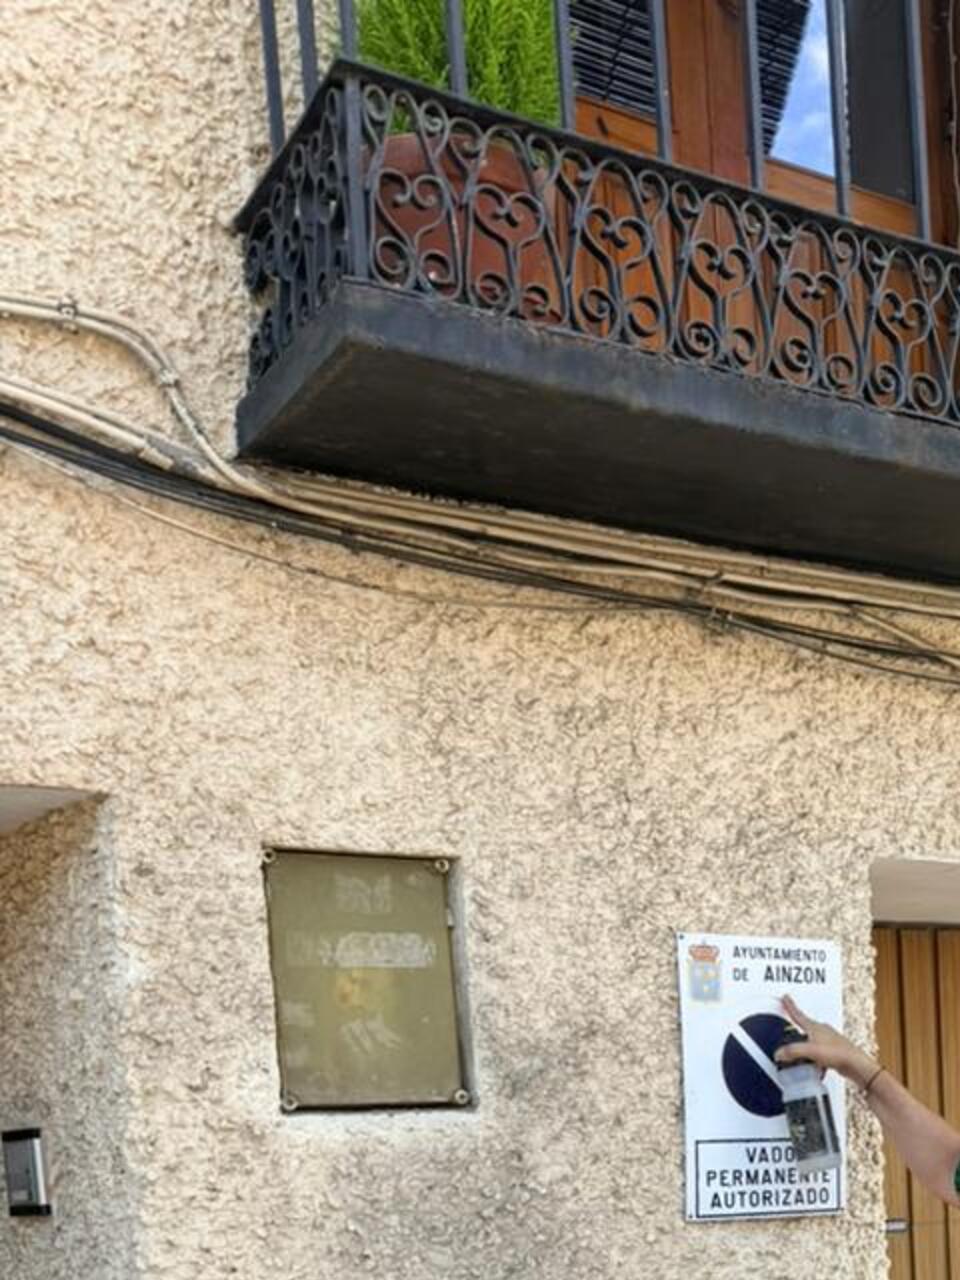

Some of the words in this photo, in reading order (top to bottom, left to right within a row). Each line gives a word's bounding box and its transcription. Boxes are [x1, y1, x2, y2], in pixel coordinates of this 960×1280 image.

[732, 945, 827, 963] AYUNTAMIENTO
[732, 967, 749, 982] DE
[763, 965, 827, 984] AINZON
[745, 1146, 796, 1164] VADO
[710, 1187, 831, 1209] AUTORIZADO
